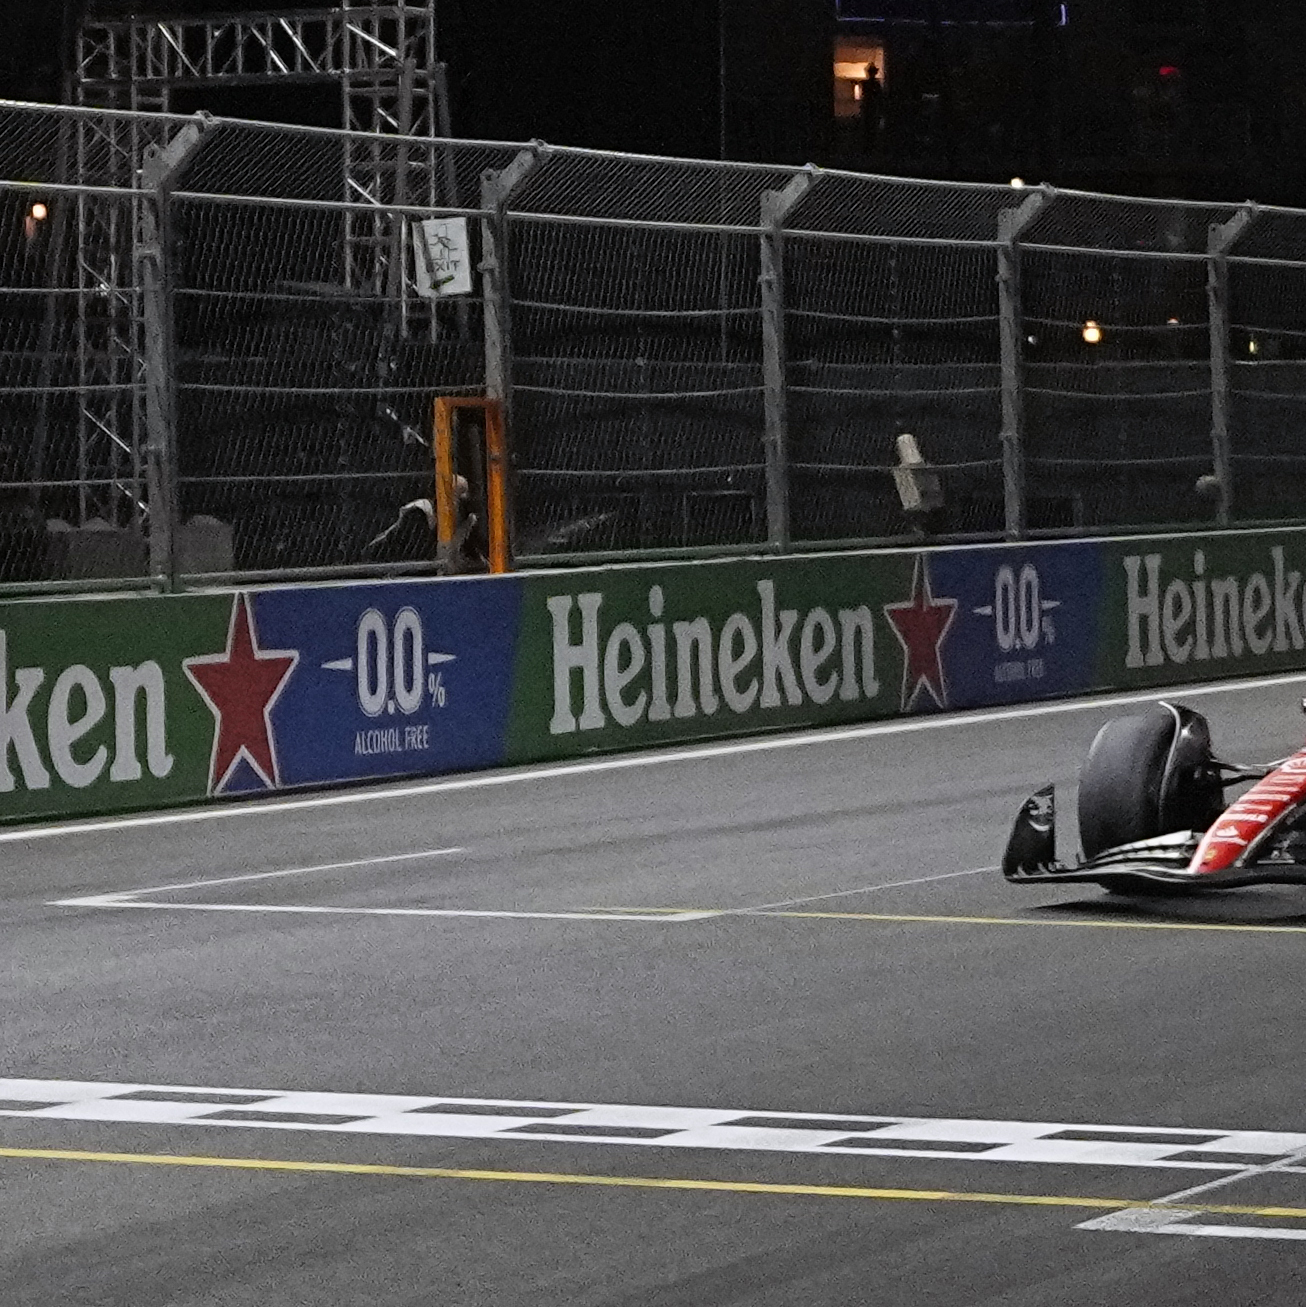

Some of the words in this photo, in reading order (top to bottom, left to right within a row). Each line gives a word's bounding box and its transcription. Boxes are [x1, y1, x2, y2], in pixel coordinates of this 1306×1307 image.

[547, 579, 881, 735] Heineken
[354, 727, 402, 756] ALCOHOL
[405, 724, 430, 750] FREE
